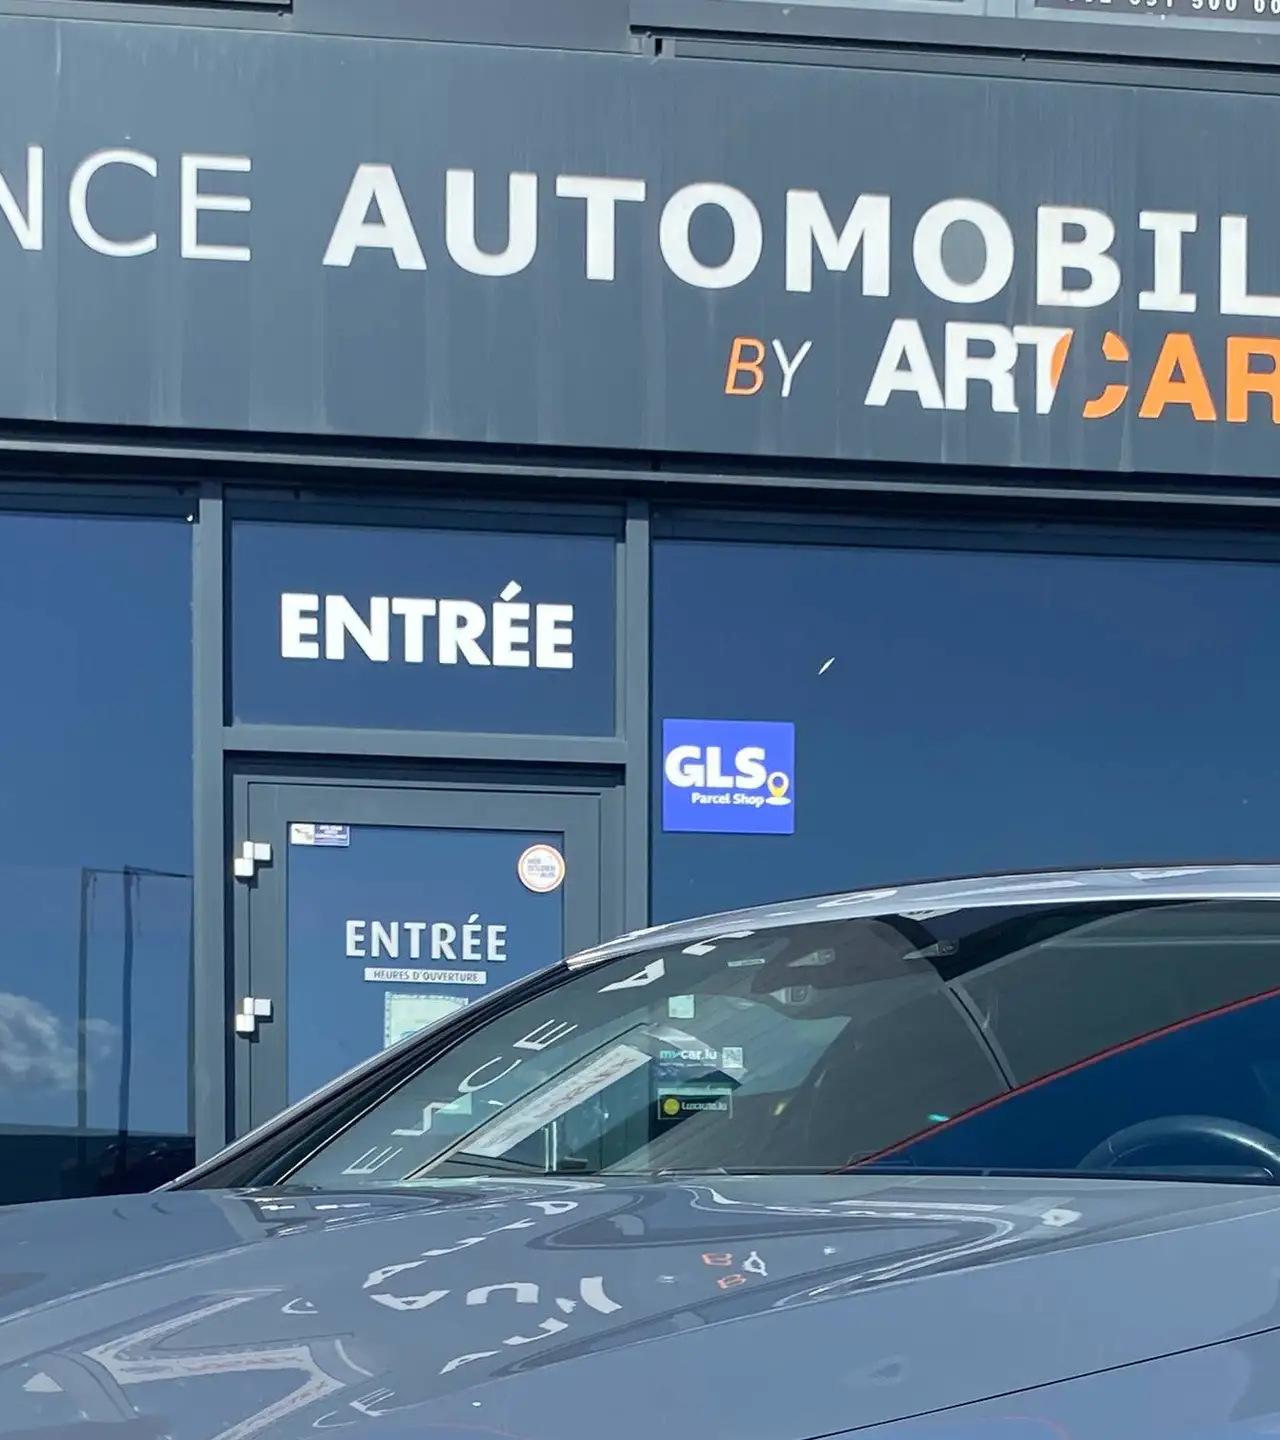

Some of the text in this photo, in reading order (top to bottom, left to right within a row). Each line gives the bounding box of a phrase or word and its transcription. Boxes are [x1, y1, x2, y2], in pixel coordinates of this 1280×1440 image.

[725, 336, 812, 398] BY
[280, 580, 574, 669] ENTRÉE
[665, 744, 768, 789] GLS
[691, 791, 765, 808] Parcel Shop
[345, 913, 508, 962] ENTRÉE
[373, 970, 479, 983] HEURES D'OUVERTURE
